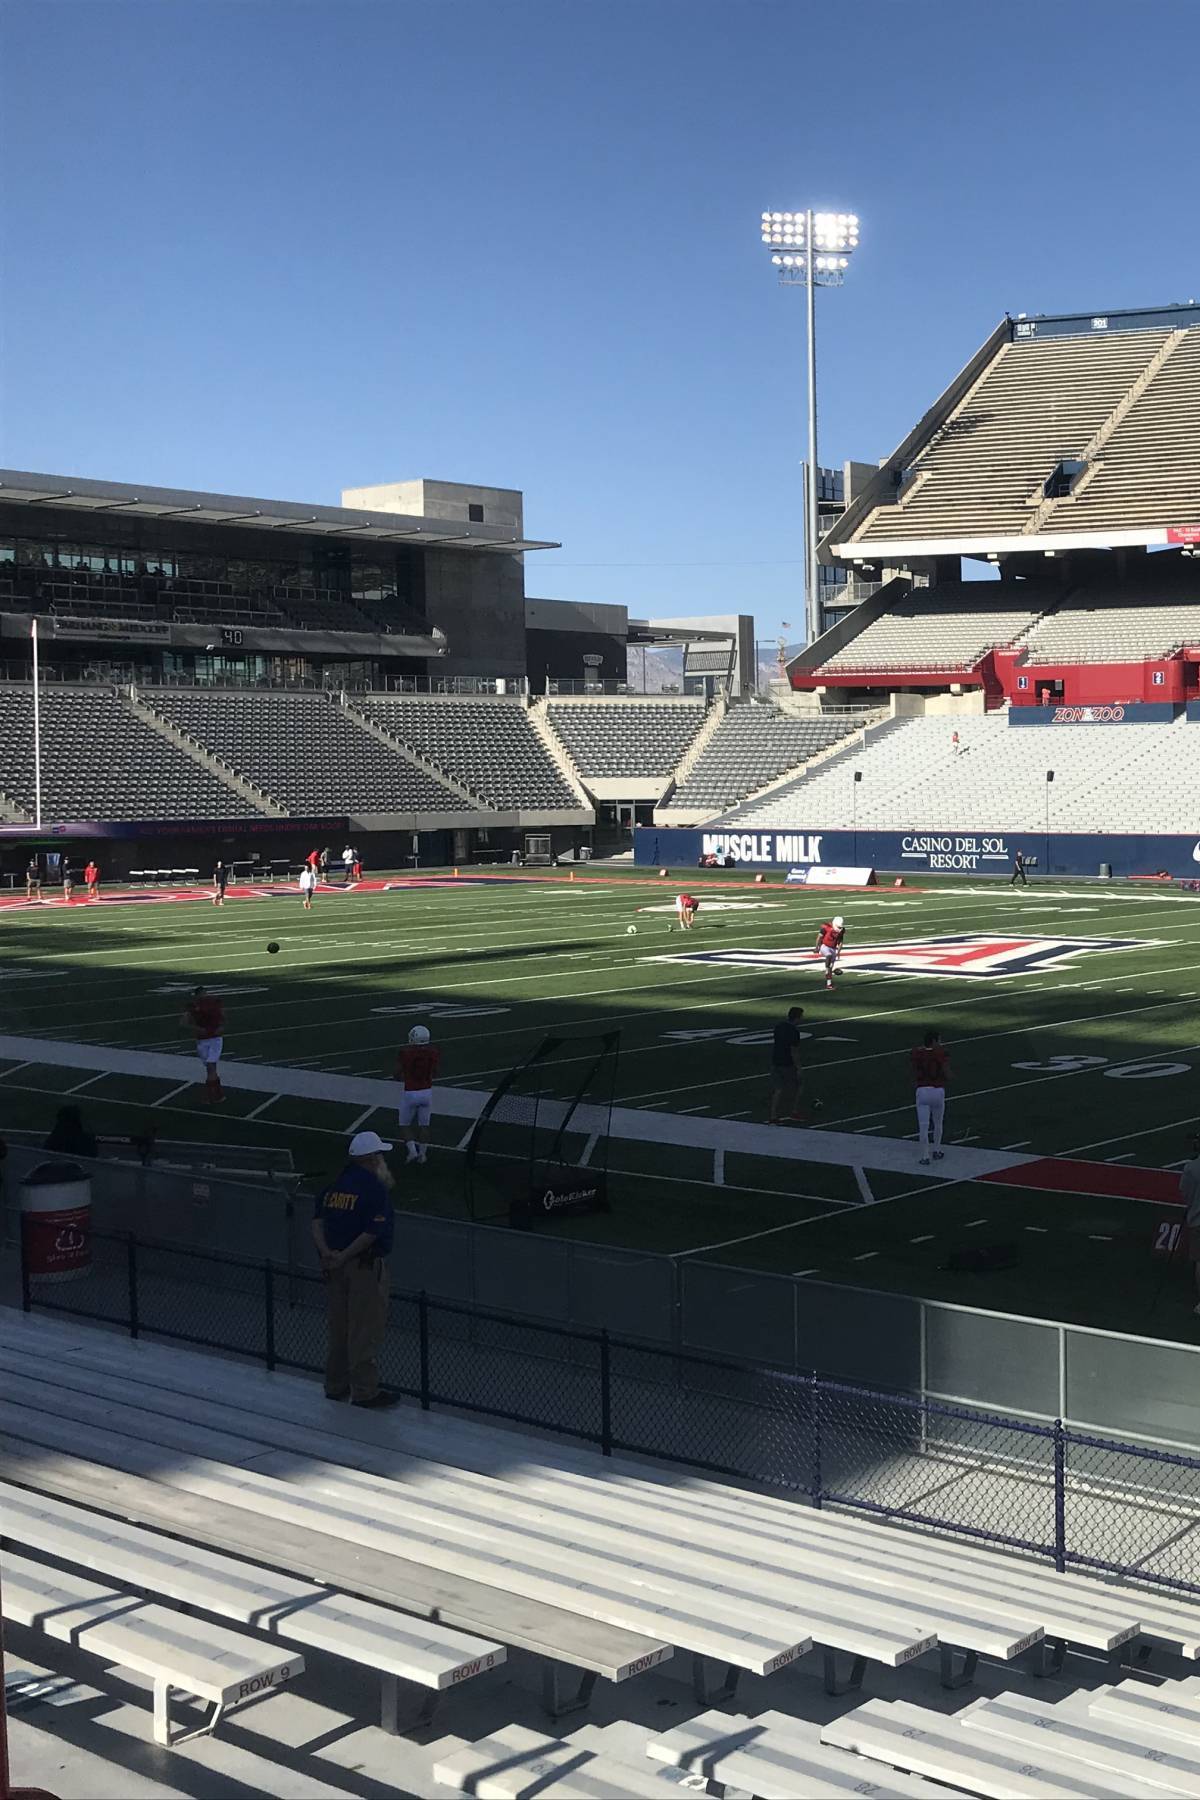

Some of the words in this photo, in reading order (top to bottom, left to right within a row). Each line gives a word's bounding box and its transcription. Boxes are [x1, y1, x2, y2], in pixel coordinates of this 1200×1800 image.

[702, 834, 772, 862] MUSCLE
[776, 835, 823, 863] MILK
[902, 837, 952, 852] CASINO
[955, 838, 981, 853] DEL
[982, 838, 1008, 853] SOL
[929, 854, 980, 869] RESORT
[904, 1645, 923, 1661] ROW
[1014, 1637, 1031, 1654] ROW
[451, 1662, 481, 1682] ROW
[486, 1654, 495, 1667] 8
[629, 1655, 653, 1675] ROW
[773, 1649, 794, 1670] ROW
[239, 1674, 274, 1698] ROW
[280, 1666, 290, 1679] 9
